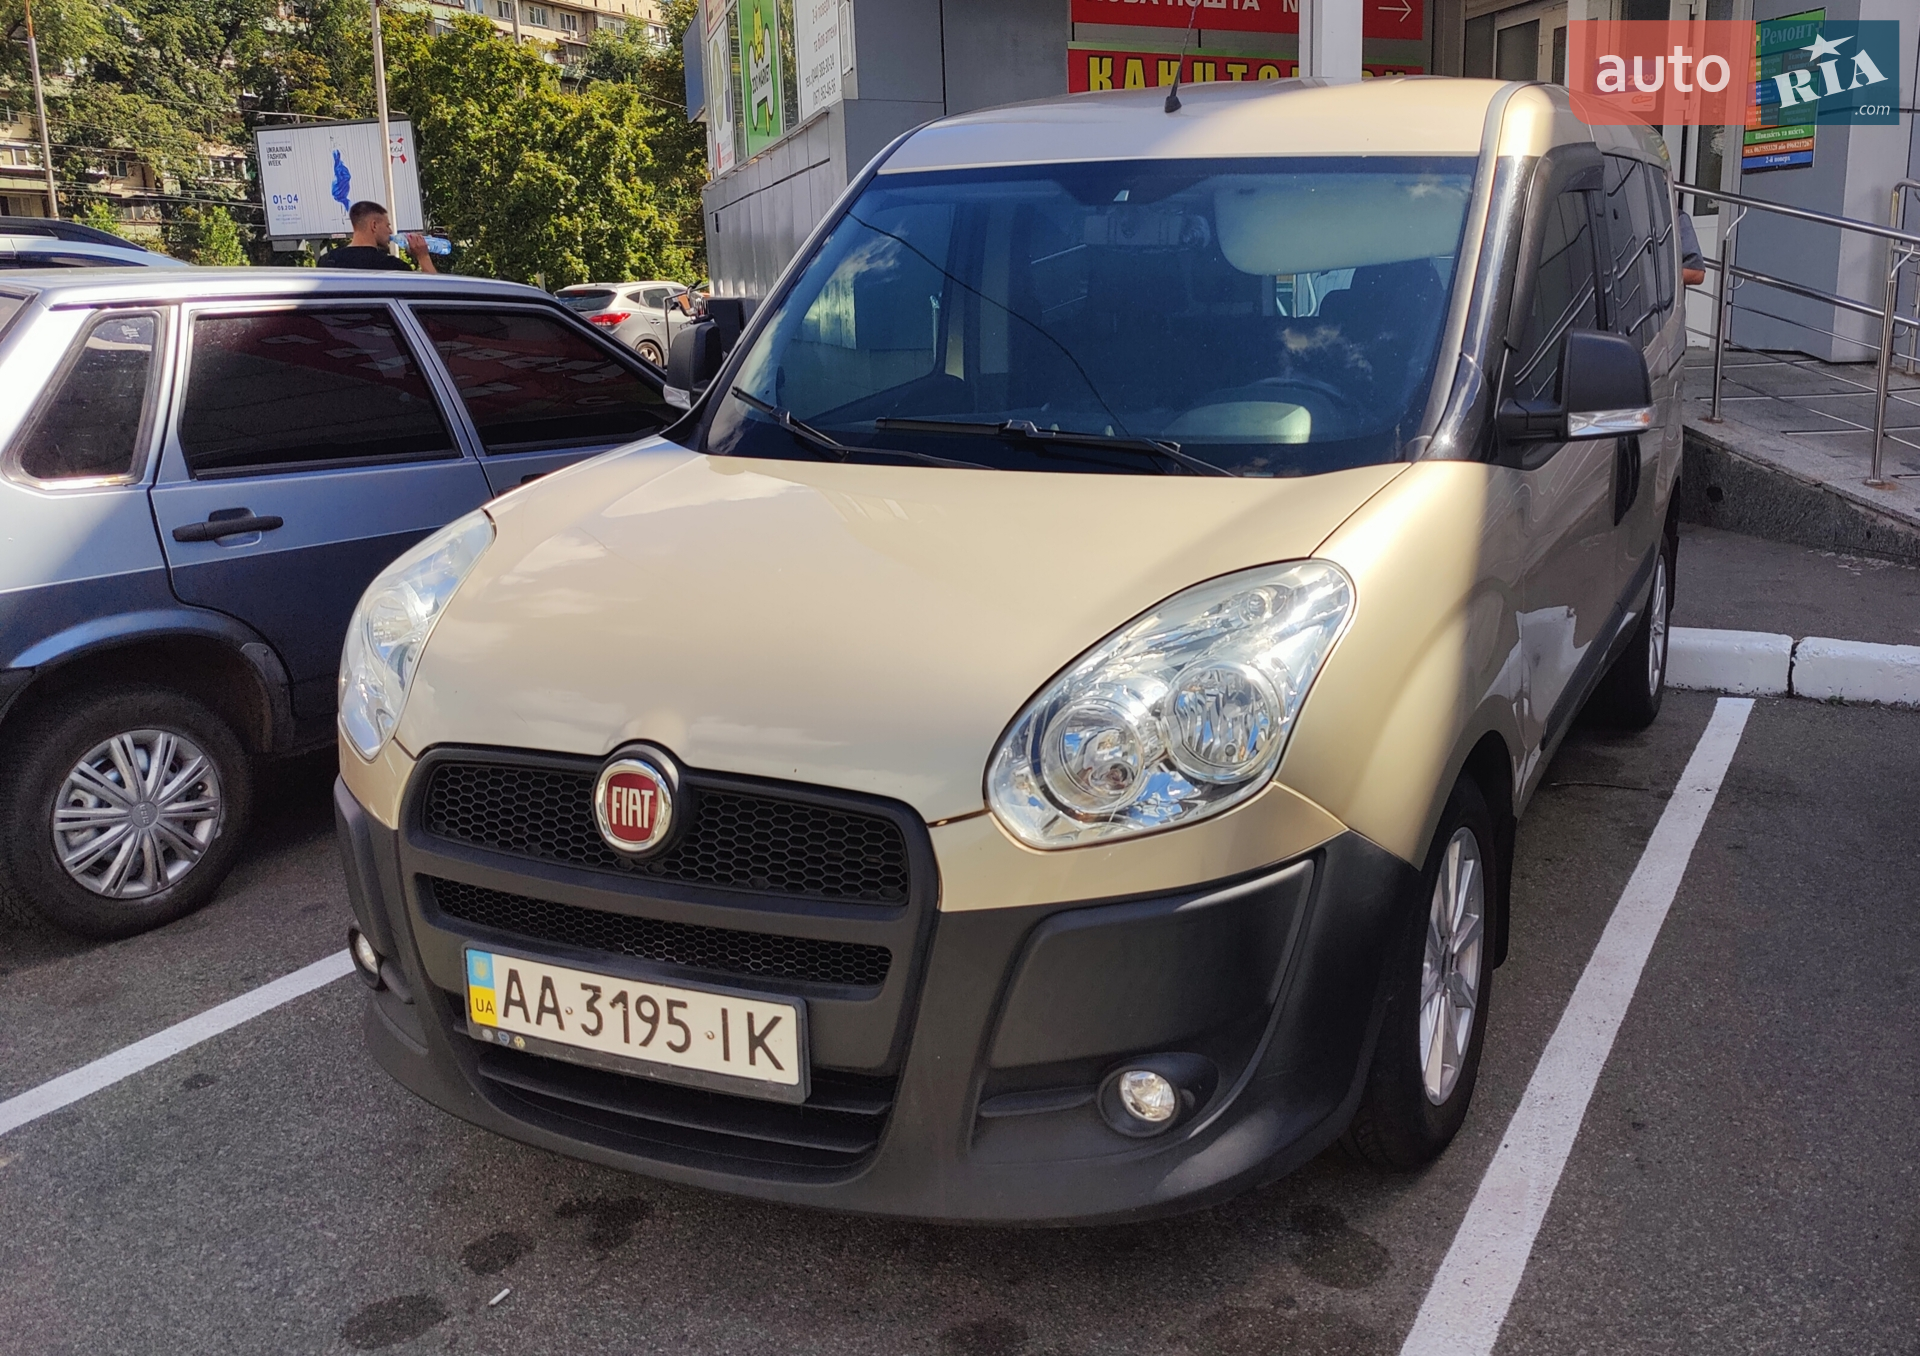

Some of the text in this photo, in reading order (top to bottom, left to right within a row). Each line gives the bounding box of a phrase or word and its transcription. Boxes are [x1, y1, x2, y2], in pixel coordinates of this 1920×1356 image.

[1761, 23, 1815, 47] Ремонт
[266, 145, 292, 154] UKRAINIAN
[272, 194, 299, 205] 01-04
[611, 786, 654, 829] FIAT
[475, 998, 495, 1015] UA
[502, 967, 785, 1072] AA 3195 IK
